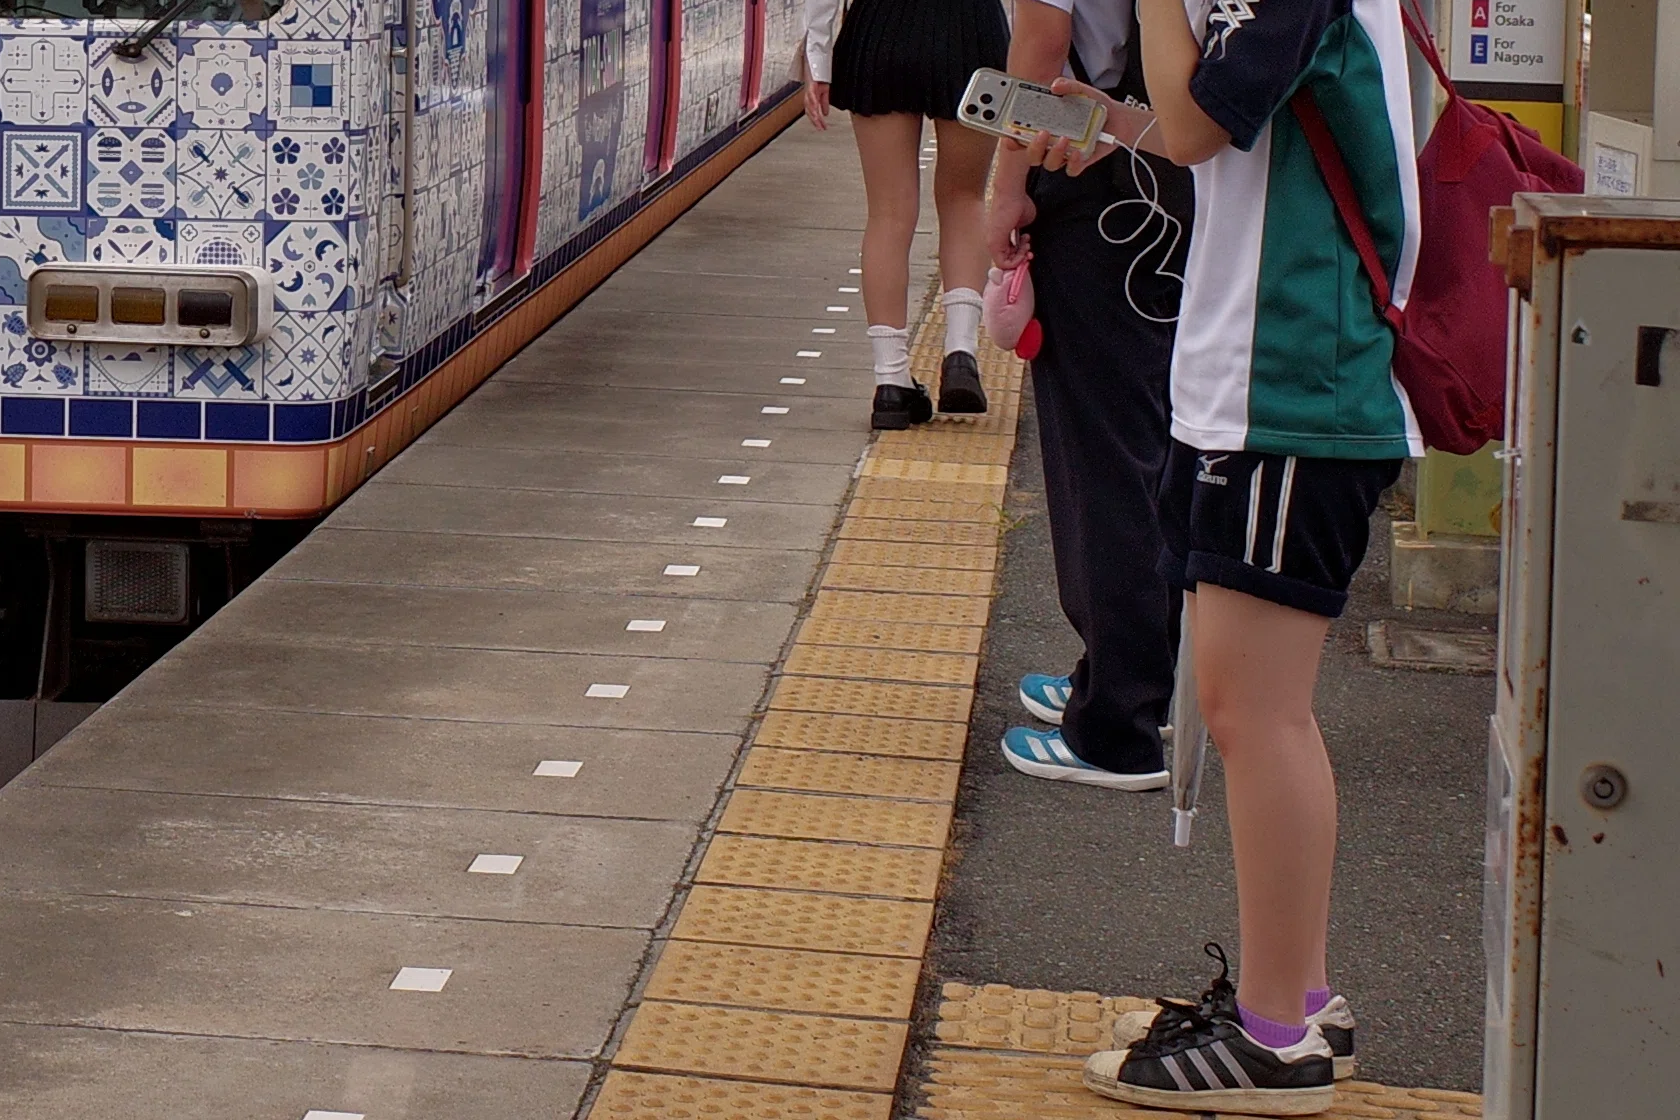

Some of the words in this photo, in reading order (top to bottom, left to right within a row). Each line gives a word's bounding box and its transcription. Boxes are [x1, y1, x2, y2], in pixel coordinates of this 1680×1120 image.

[1474, 6, 1486, 20] A
[1495, 2, 1516, 13] For
[1494, 14, 1534, 27] Osaka
[1475, 42, 1485, 56] E
[1494, 38, 1515, 49] For
[1494, 51, 1544, 66] Nagoya
